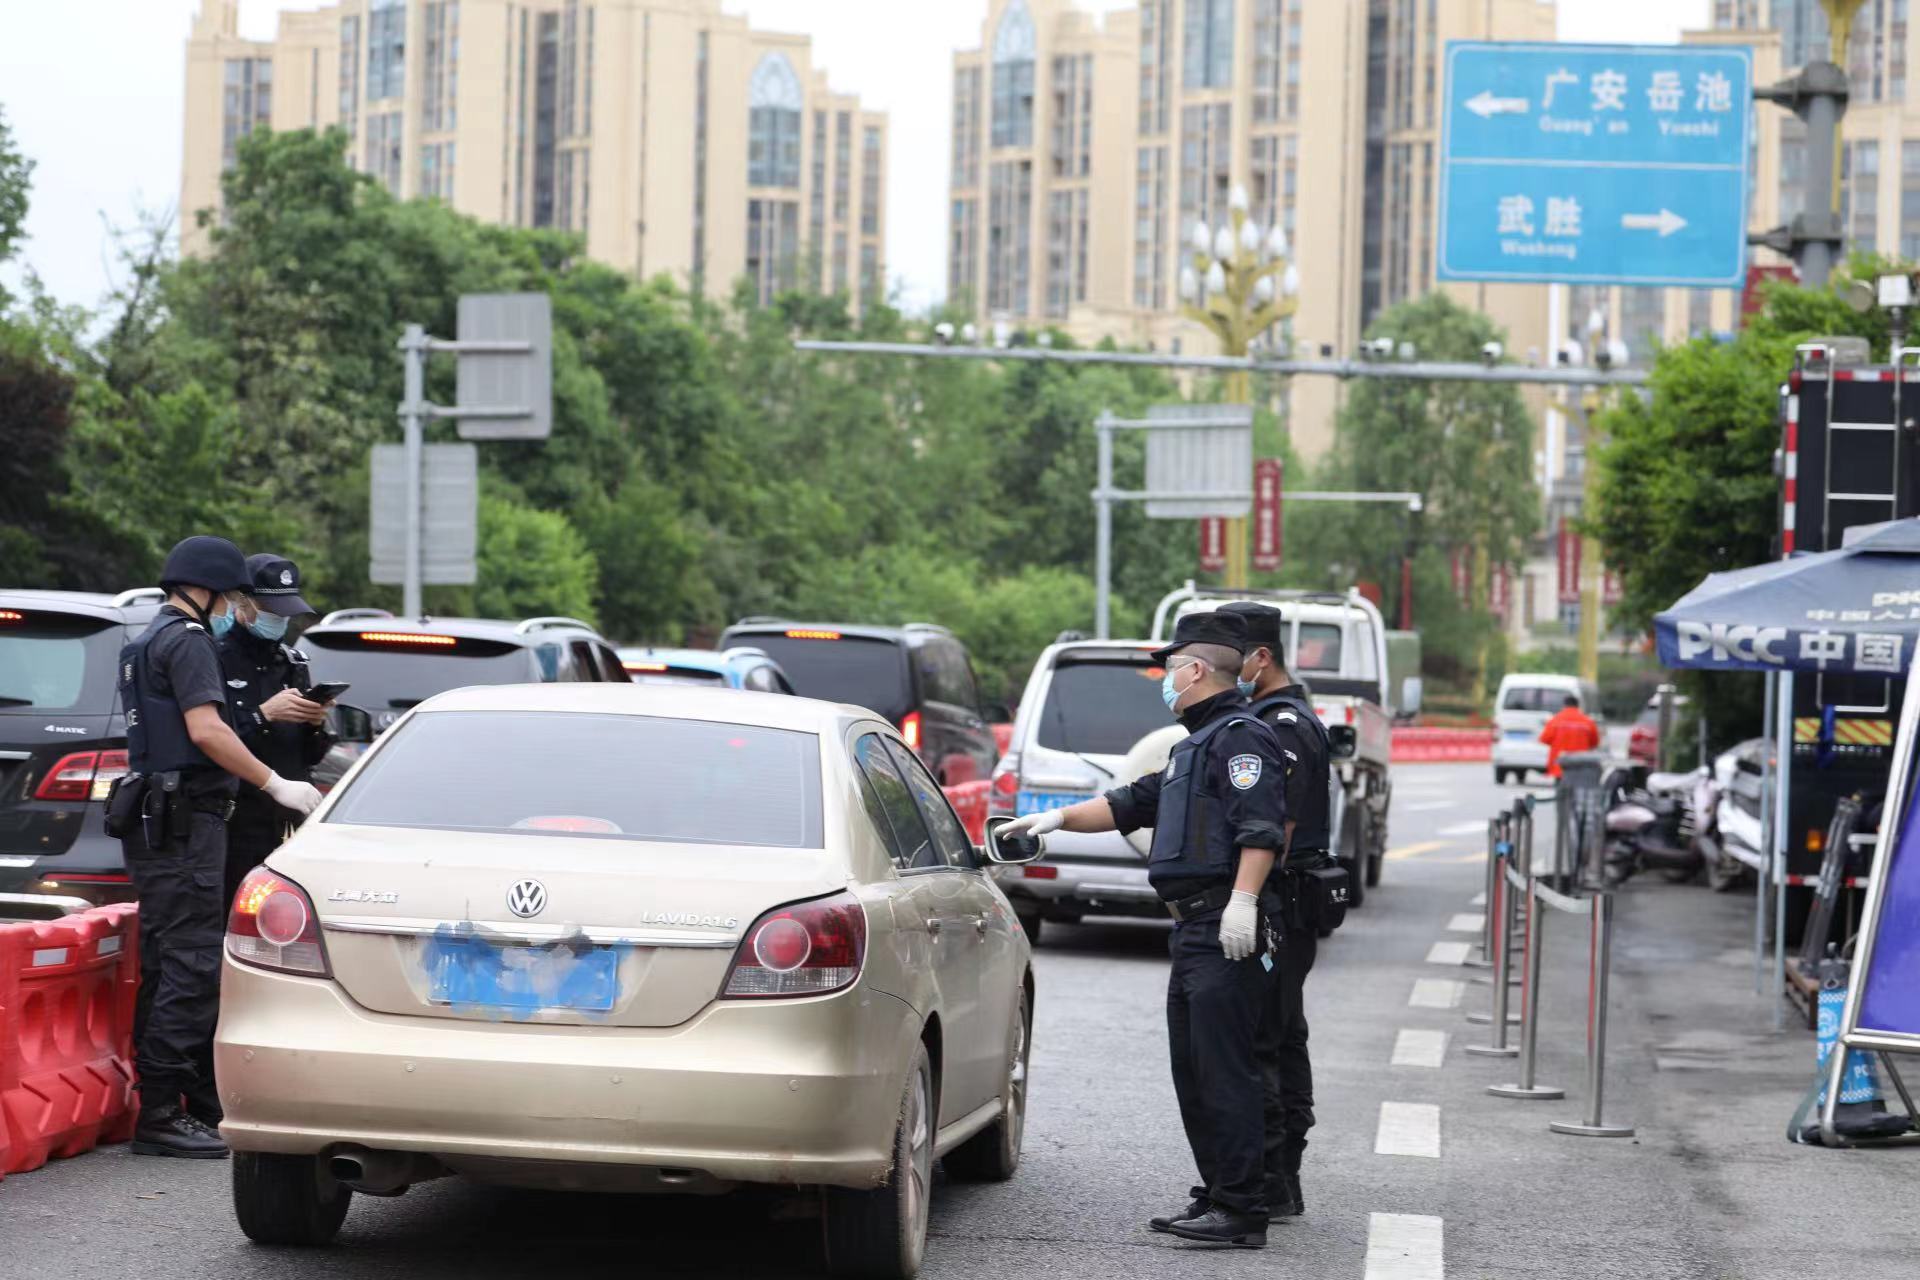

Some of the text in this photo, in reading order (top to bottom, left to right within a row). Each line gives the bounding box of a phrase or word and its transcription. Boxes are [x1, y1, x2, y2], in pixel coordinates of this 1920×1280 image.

[1497, 195, 1583, 237] 武胜
[1677, 621, 1903, 673] PICC 中国
